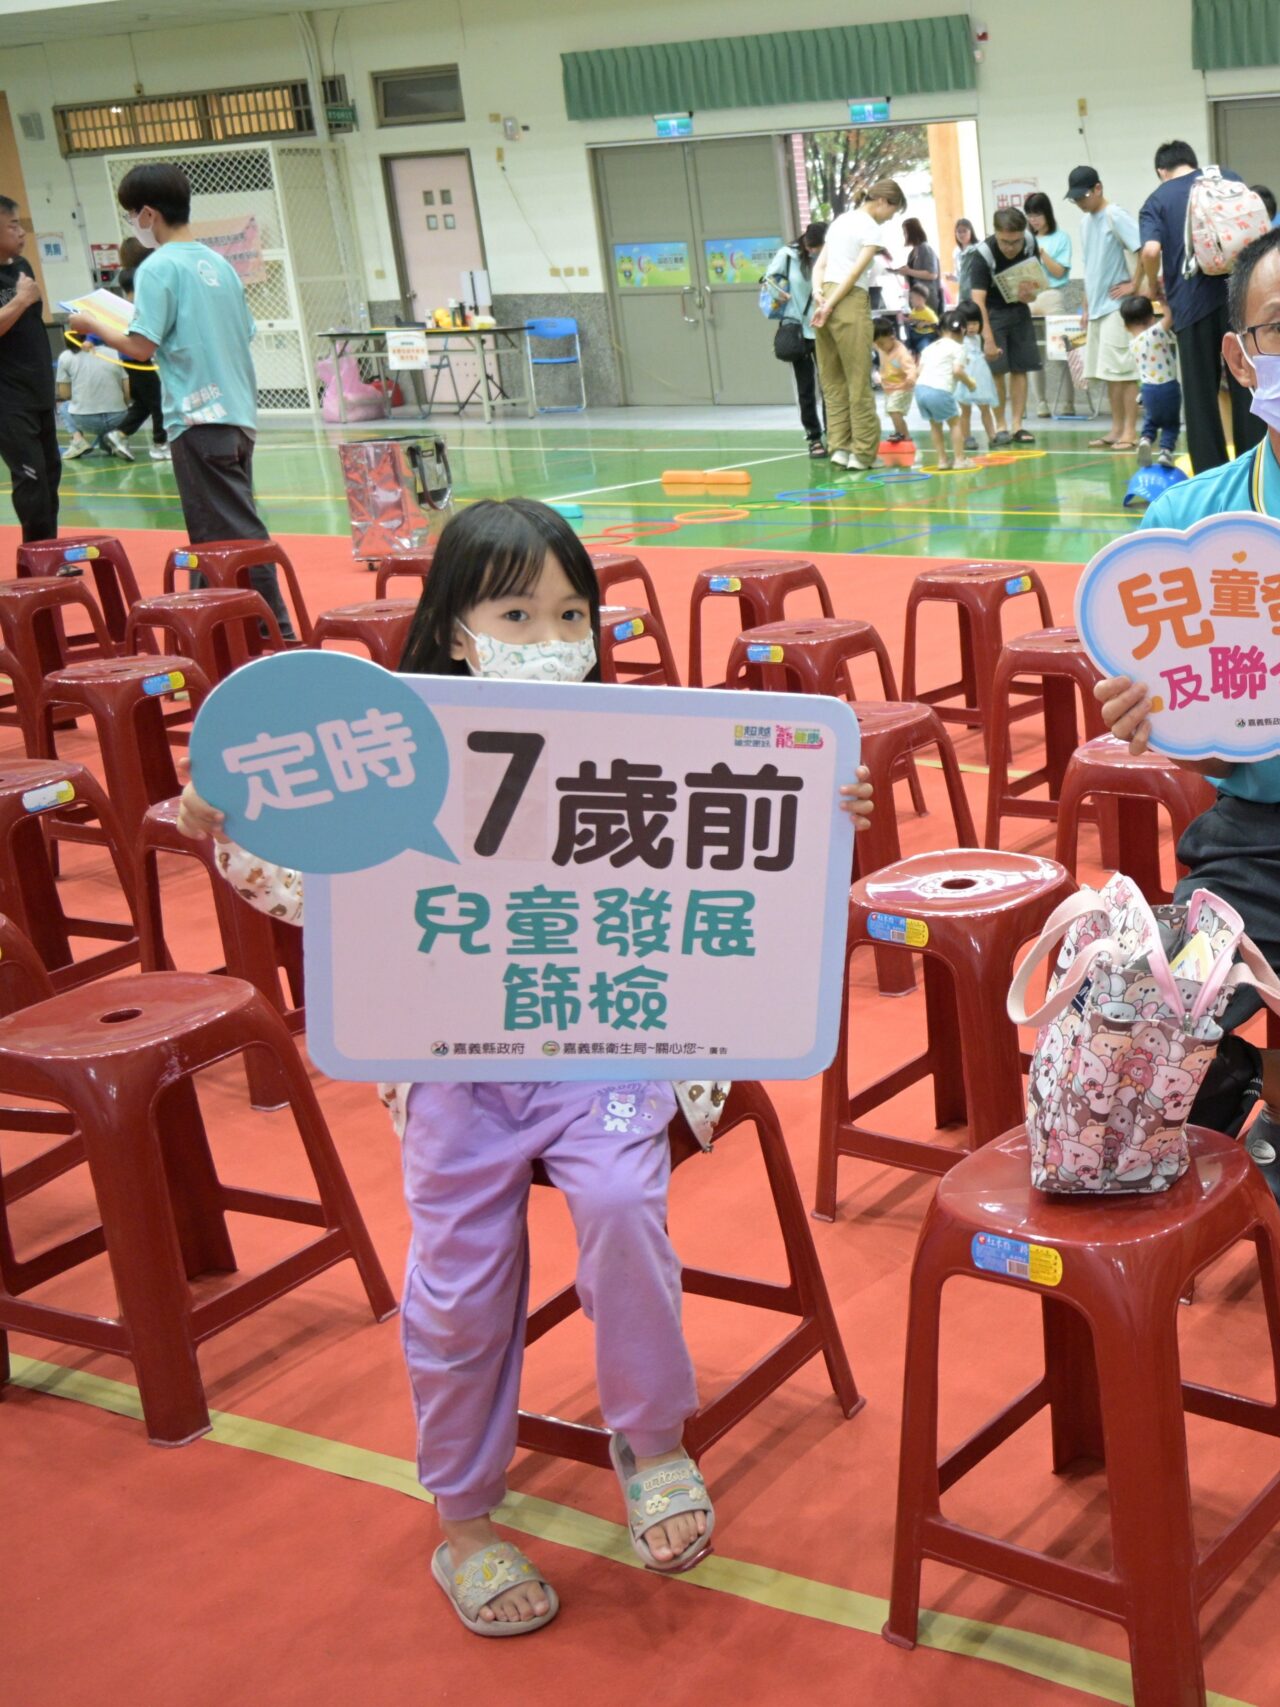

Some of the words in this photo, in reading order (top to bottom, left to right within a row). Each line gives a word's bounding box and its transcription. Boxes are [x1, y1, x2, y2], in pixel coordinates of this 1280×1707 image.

[997, 192, 1036, 208] 出口
[222, 708, 418, 821] 定時
[466, 730, 805, 873] 7歲前
[413, 883, 757, 960] 兒童發展
[502, 963, 670, 1032] 篩檢
[453, 1042, 525, 1055] 嘉義縣政府
[709, 1046, 728, 1055] 廣告
